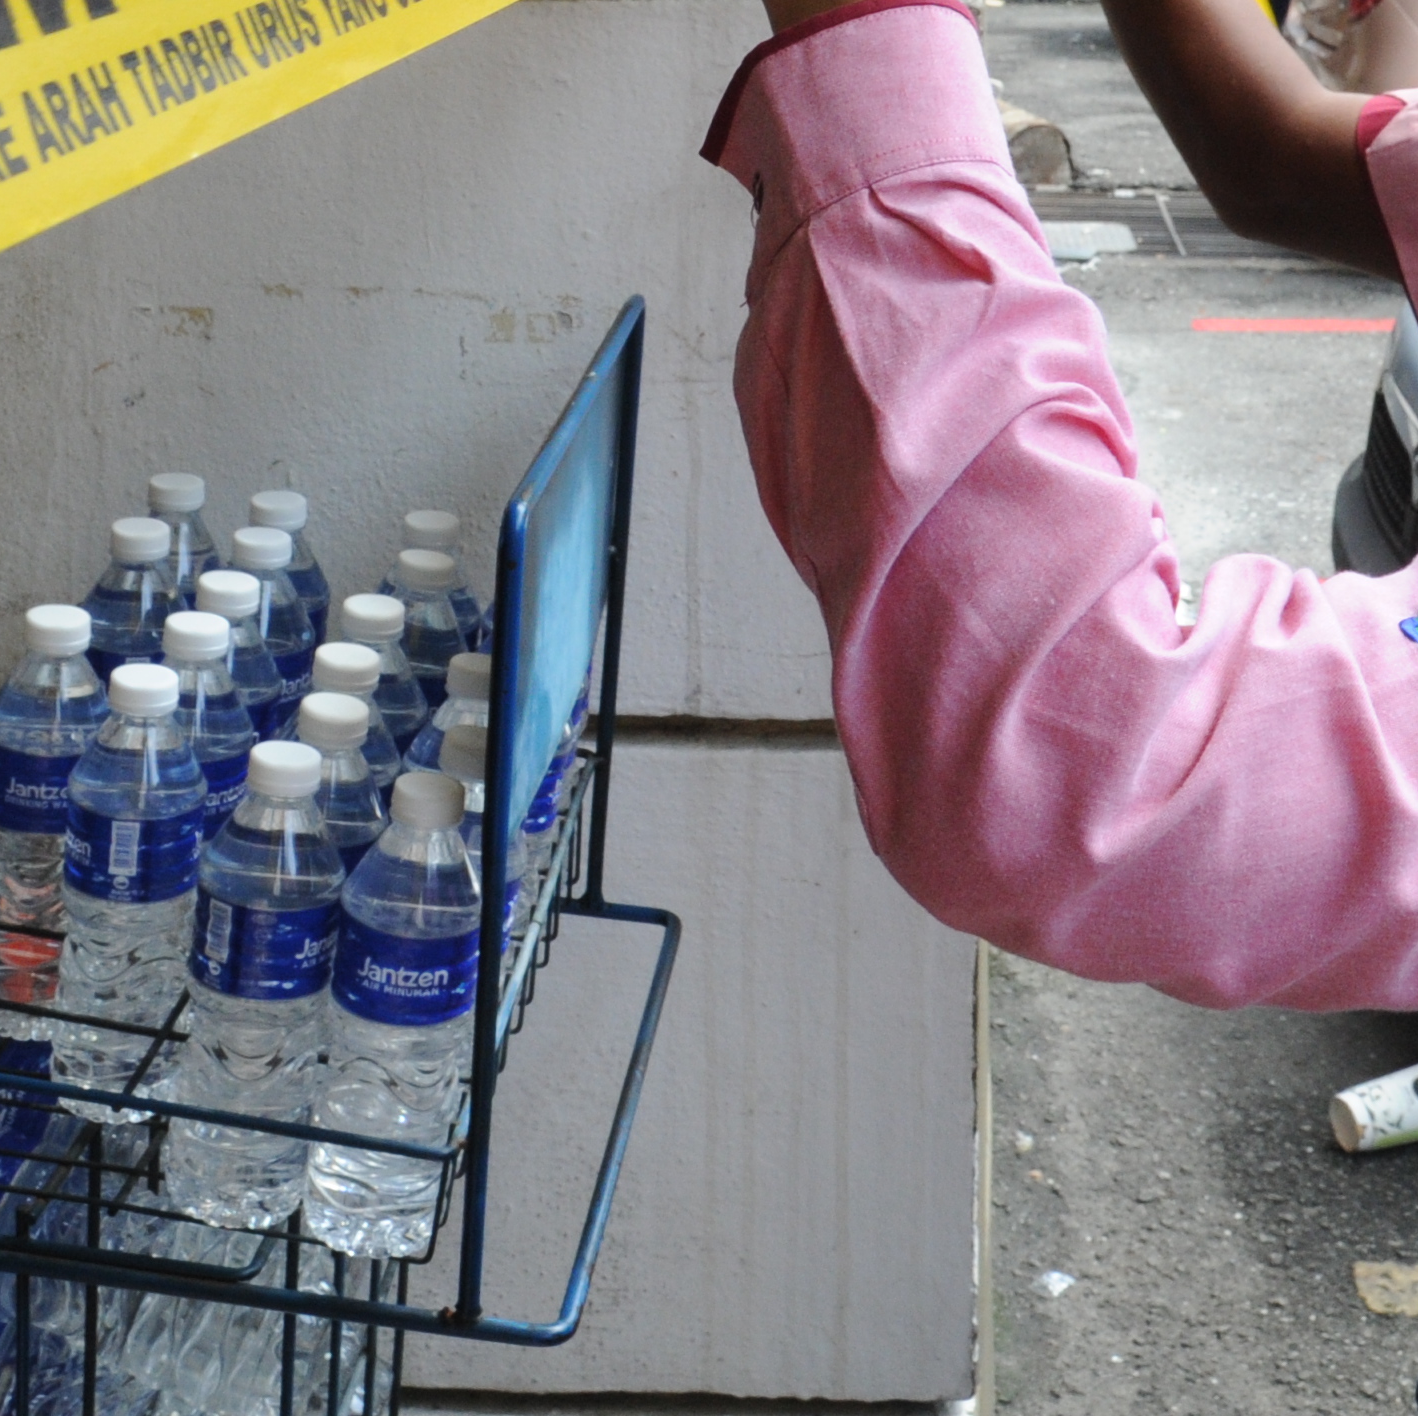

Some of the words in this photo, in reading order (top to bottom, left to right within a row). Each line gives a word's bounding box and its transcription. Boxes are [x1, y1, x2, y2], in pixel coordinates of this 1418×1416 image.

[31, 58, 130, 165] ARAH
[119, 22, 238, 116] TADBIR
[356, 956, 450, 989] Jantzen
[361, 980, 380, 993] AIR
[382, 985, 441, 998] MINUMAN
